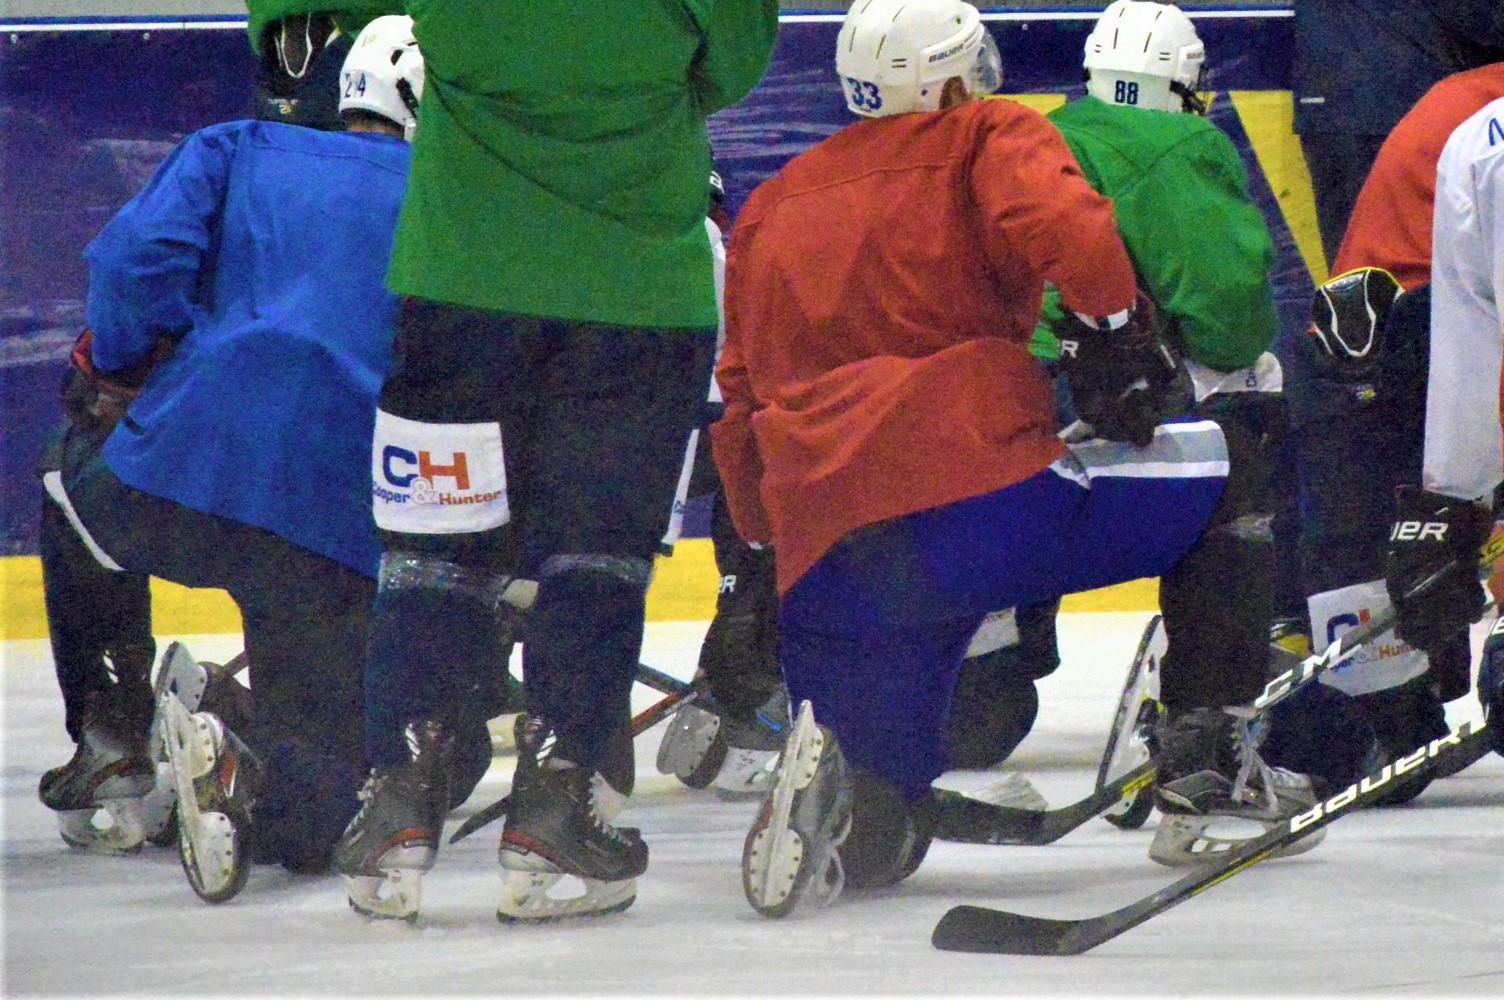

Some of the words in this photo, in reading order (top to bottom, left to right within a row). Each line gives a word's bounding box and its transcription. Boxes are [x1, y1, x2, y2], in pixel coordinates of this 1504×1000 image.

[344, 73, 367, 98] 24
[846, 76, 883, 110] 33
[1114, 80, 1140, 105] 88
[383, 444, 470, 490] CH
[438, 490, 501, 505] Hunter
